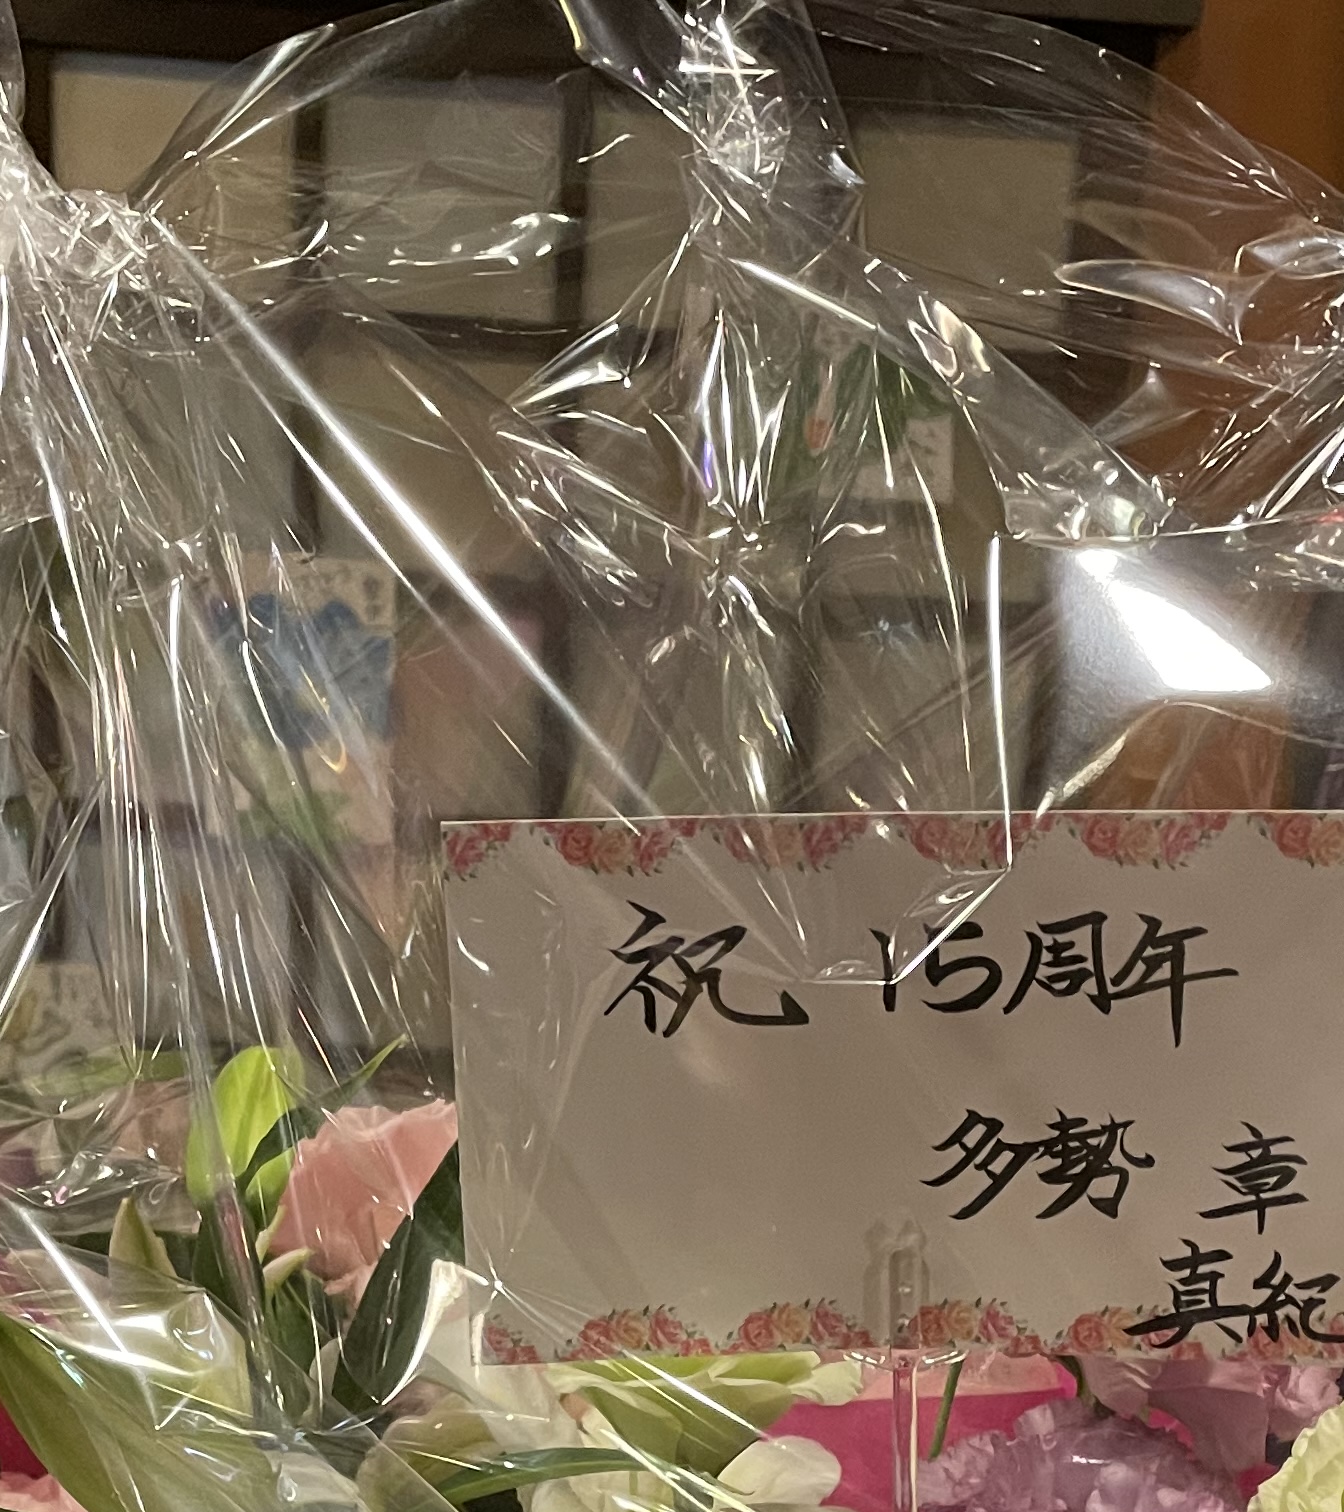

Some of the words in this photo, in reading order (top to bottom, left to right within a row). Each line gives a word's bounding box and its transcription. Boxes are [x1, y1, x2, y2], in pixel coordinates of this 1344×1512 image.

[603, 900, 811, 1039] 祝
[868, 910, 1240, 1049] 15周年
[919, 1106, 1156, 1221] 多勢
[1196, 1119, 1311, 1236] 章
